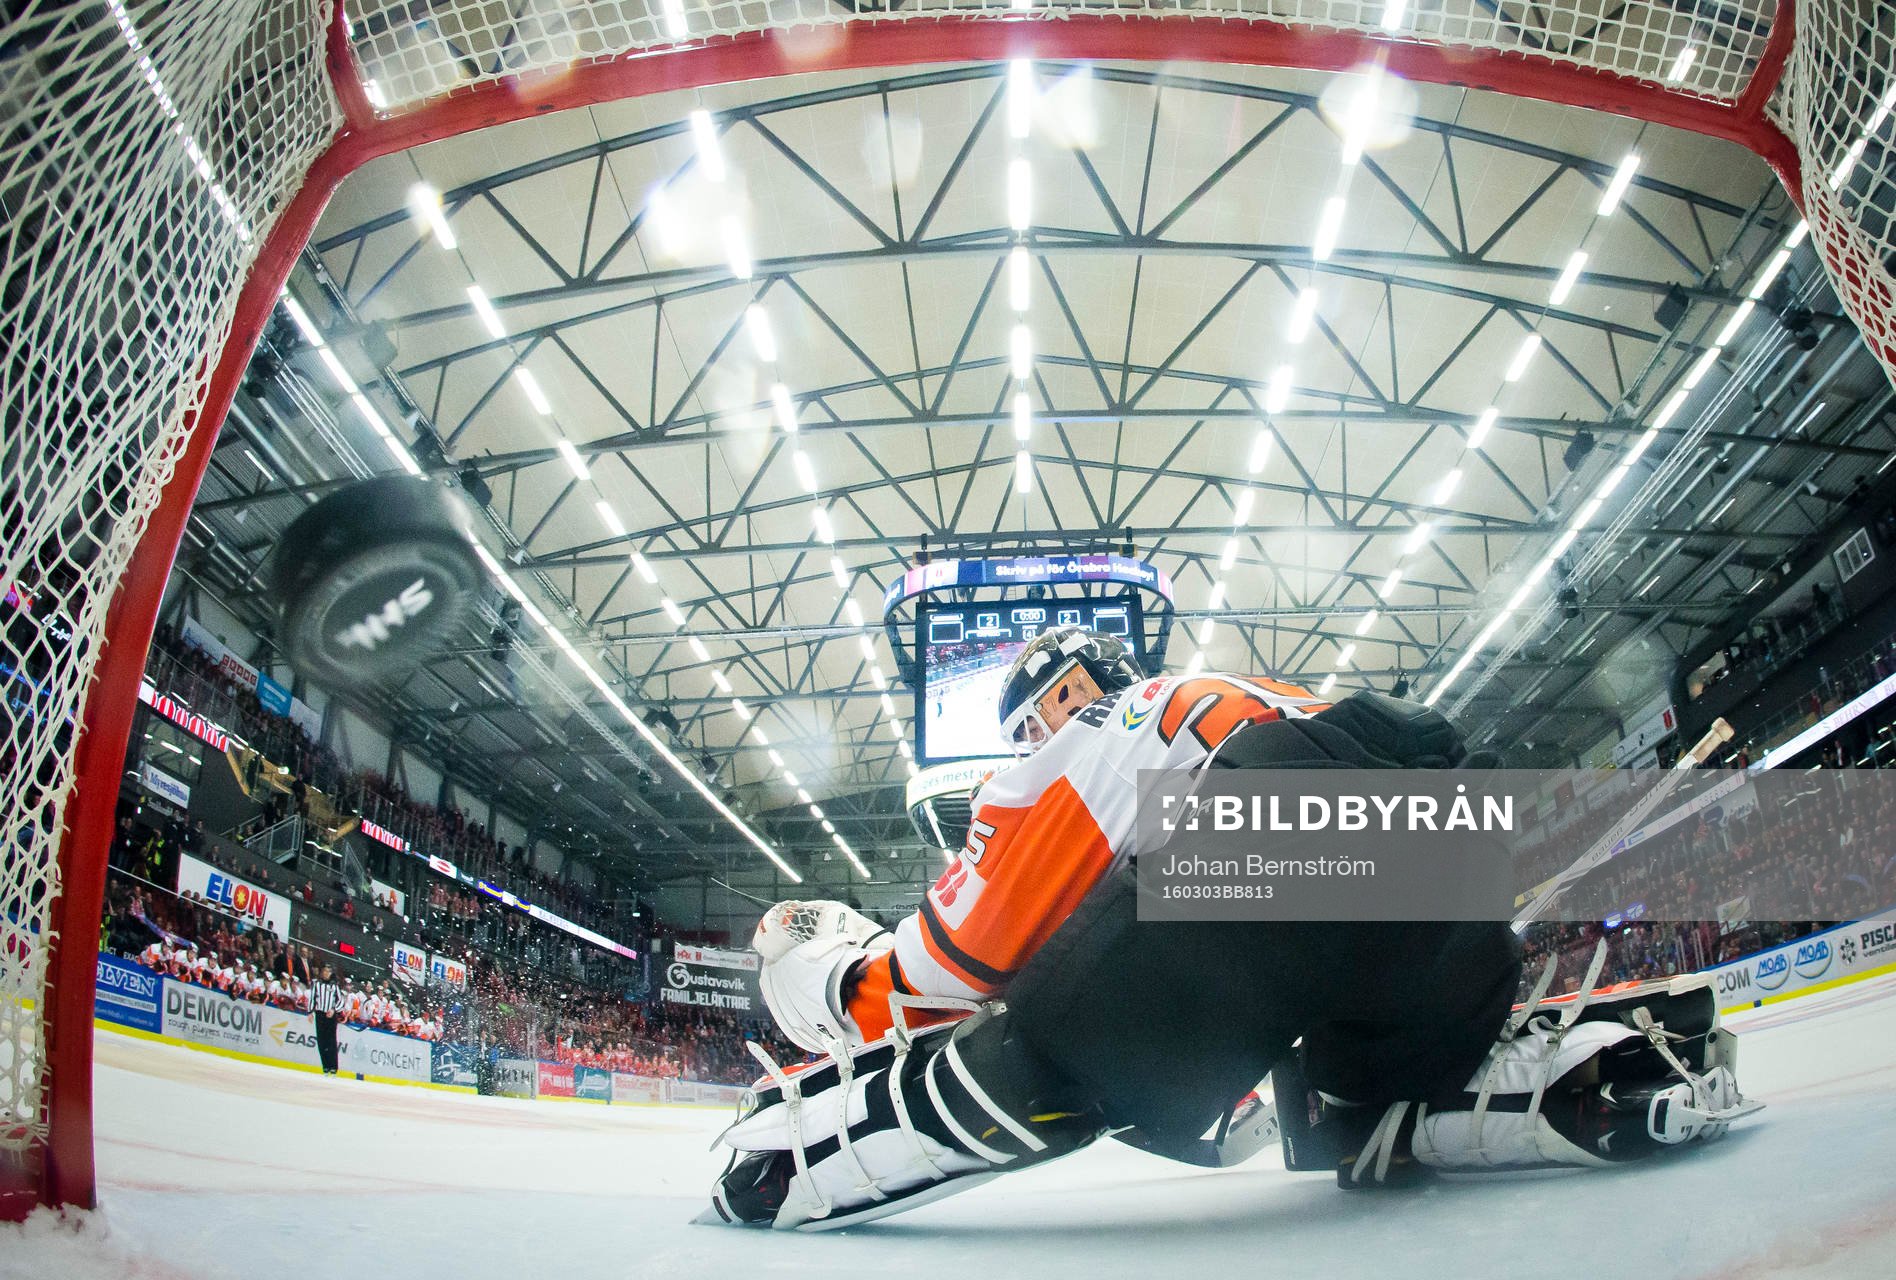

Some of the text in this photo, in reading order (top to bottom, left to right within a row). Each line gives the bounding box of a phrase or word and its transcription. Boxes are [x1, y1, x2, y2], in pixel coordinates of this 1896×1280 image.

[995, 565, 1025, 577] Skriv
[1028, 563, 1045, 577] på
[1046, 563, 1066, 575] för
[1066, 561, 1112, 574] Örebro
[985, 615, 994, 627] 2
[1019, 610, 1041, 621] 0:00
[1063, 612, 1072, 624] 2
[206, 873, 267, 918] ELON
[1860, 922, 1896, 949] PISC
[397, 950, 423, 971] ELON
[1794, 940, 1830, 966] MOAB
[433, 961, 465, 983] ELON
[667, 963, 746, 991] Gustavsvik
[1755, 953, 1788, 979] MOAB
[660, 987, 751, 1010] FAMILJELÄKTARE
[166, 987, 263, 1035] DEMCOM
[284, 1031, 348, 1054] EASN
[370, 1049, 421, 1071] CONCENT
